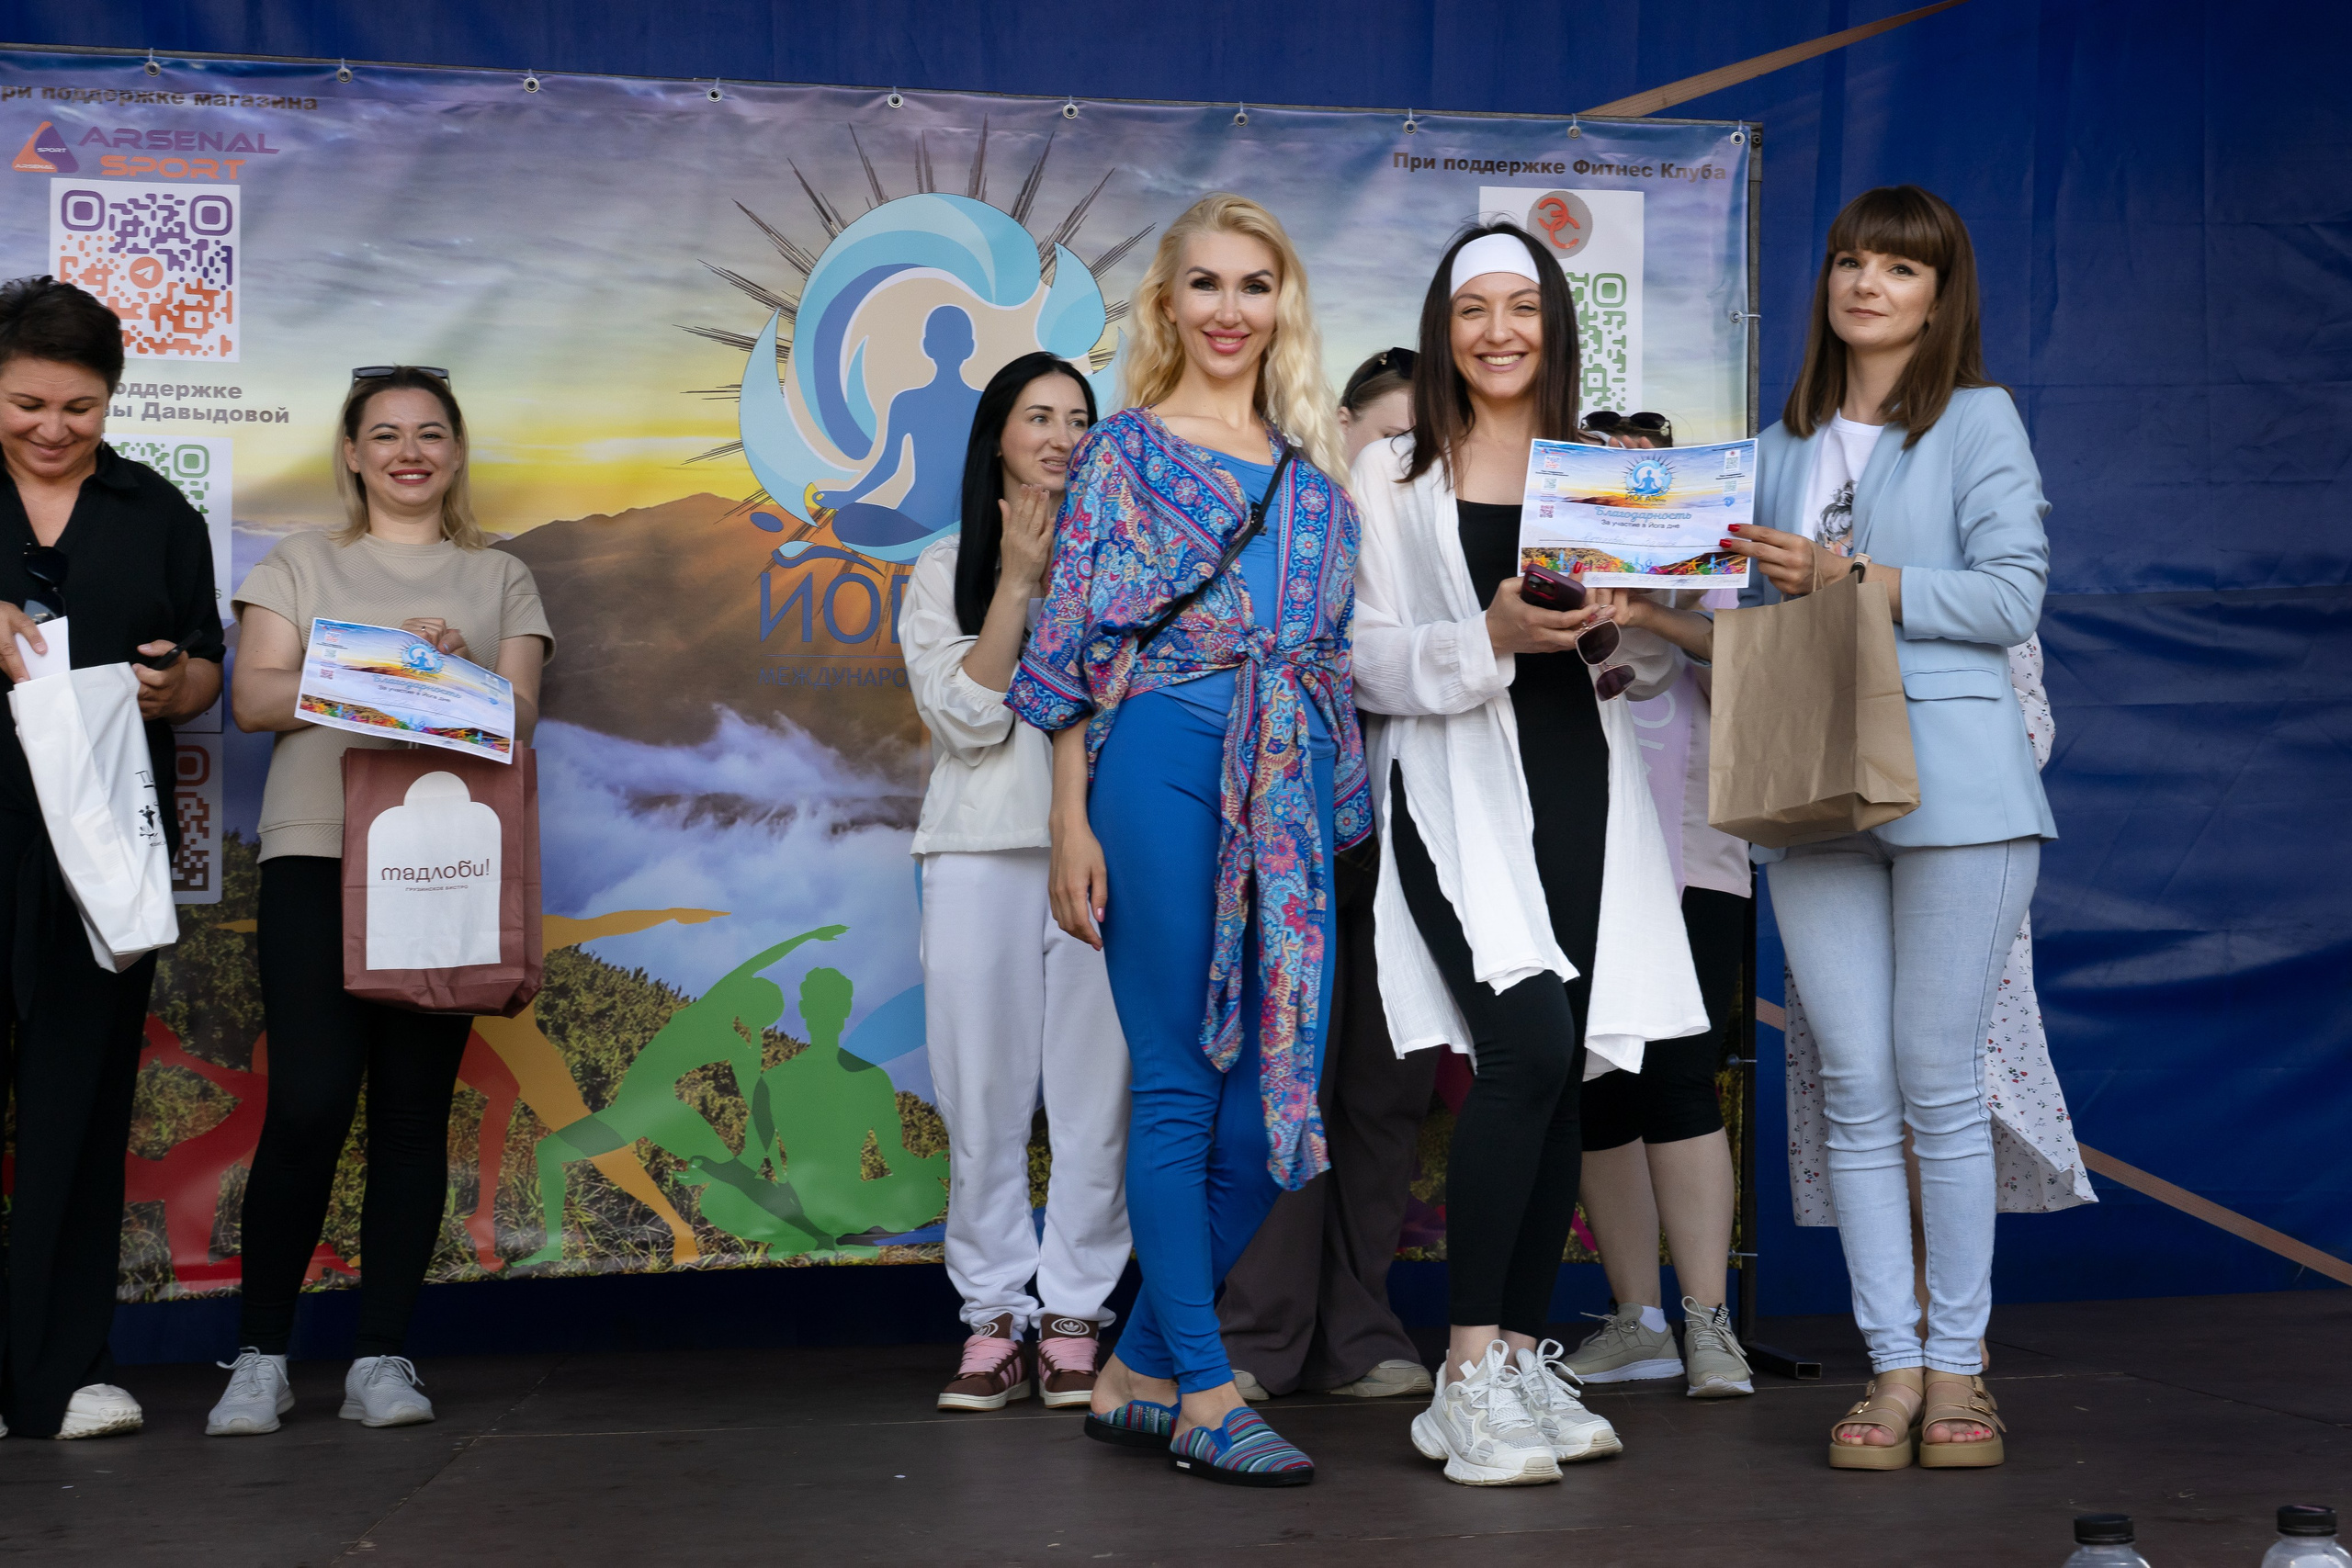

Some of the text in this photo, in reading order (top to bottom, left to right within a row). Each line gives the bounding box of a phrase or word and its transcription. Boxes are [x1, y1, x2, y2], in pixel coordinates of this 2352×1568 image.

[1, 85, 319, 111] ри поддержке магазина
[78, 126, 280, 154] ARSENAL
[100, 154, 246, 180] SPORT
[1393, 152, 1726, 183] При поддержке Фитнес Клуба
[115, 382, 243, 401] оддержке
[141, 401, 289, 424] Давыдовой
[758, 666, 911, 692] МЕЖДУНАРО
